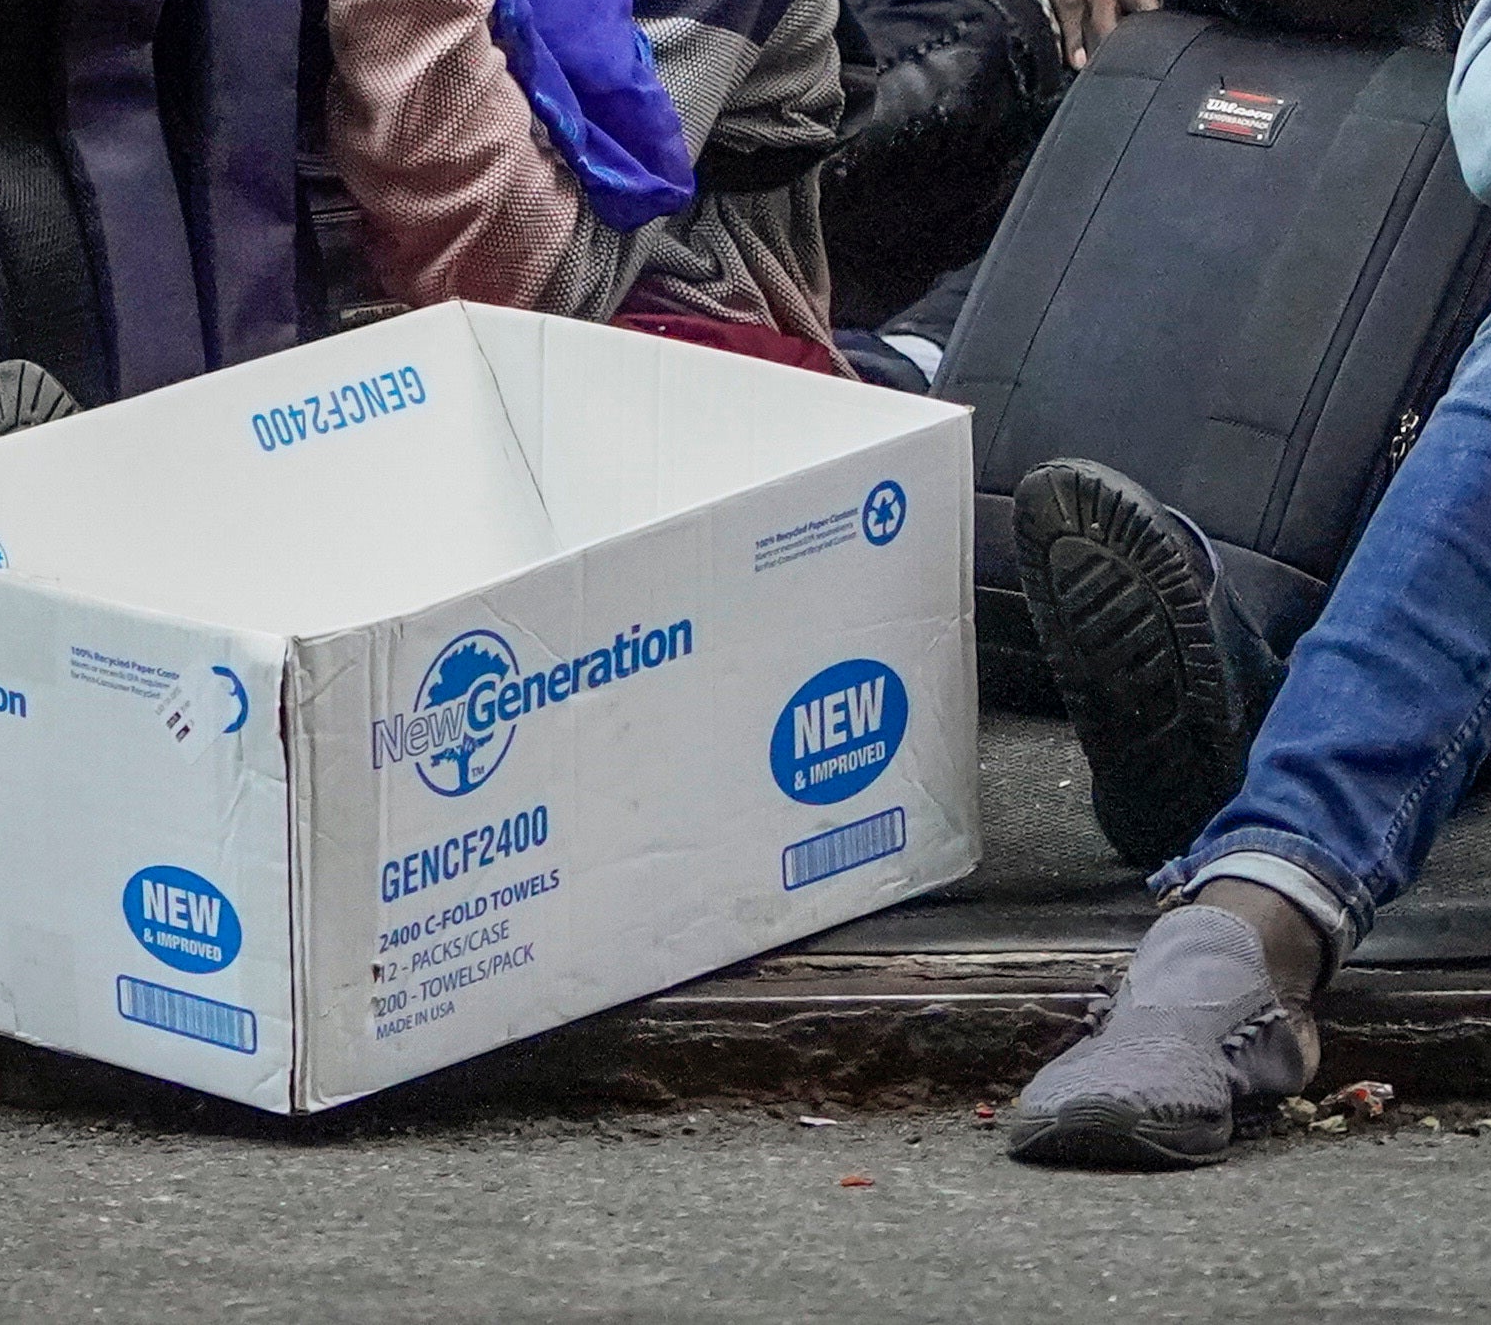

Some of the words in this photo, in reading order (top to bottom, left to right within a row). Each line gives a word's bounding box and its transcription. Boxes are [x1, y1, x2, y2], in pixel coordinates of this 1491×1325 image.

[1206, 98, 1273, 121] Wilson
[253, 365, 427, 453] GENCF2400
[131, 661, 156, 676] Paper
[793, 674, 886, 760] NEW
[794, 770, 806, 792] &
[810, 740, 886, 785] IMPROVED
[381, 805, 548, 902] GENCF2400
[142, 879, 220, 937] NEW
[378, 921, 421, 954] 2400
[425, 897, 487, 935] C-FOLD
[490, 869, 560, 911] TOWELS
[143, 927, 153, 944] &
[157, 931, 222, 963] IMPROVED
[377, 962, 397, 984] 12
[411, 919, 510, 973] PACKS/CASE
[377, 990, 407, 1017] 200
[420, 942, 535, 1001] TOWELS/PACK
[375, 1019, 412, 1040] MADE
[414, 1011, 428, 1027] IN
[430, 1001, 455, 1021] USA
